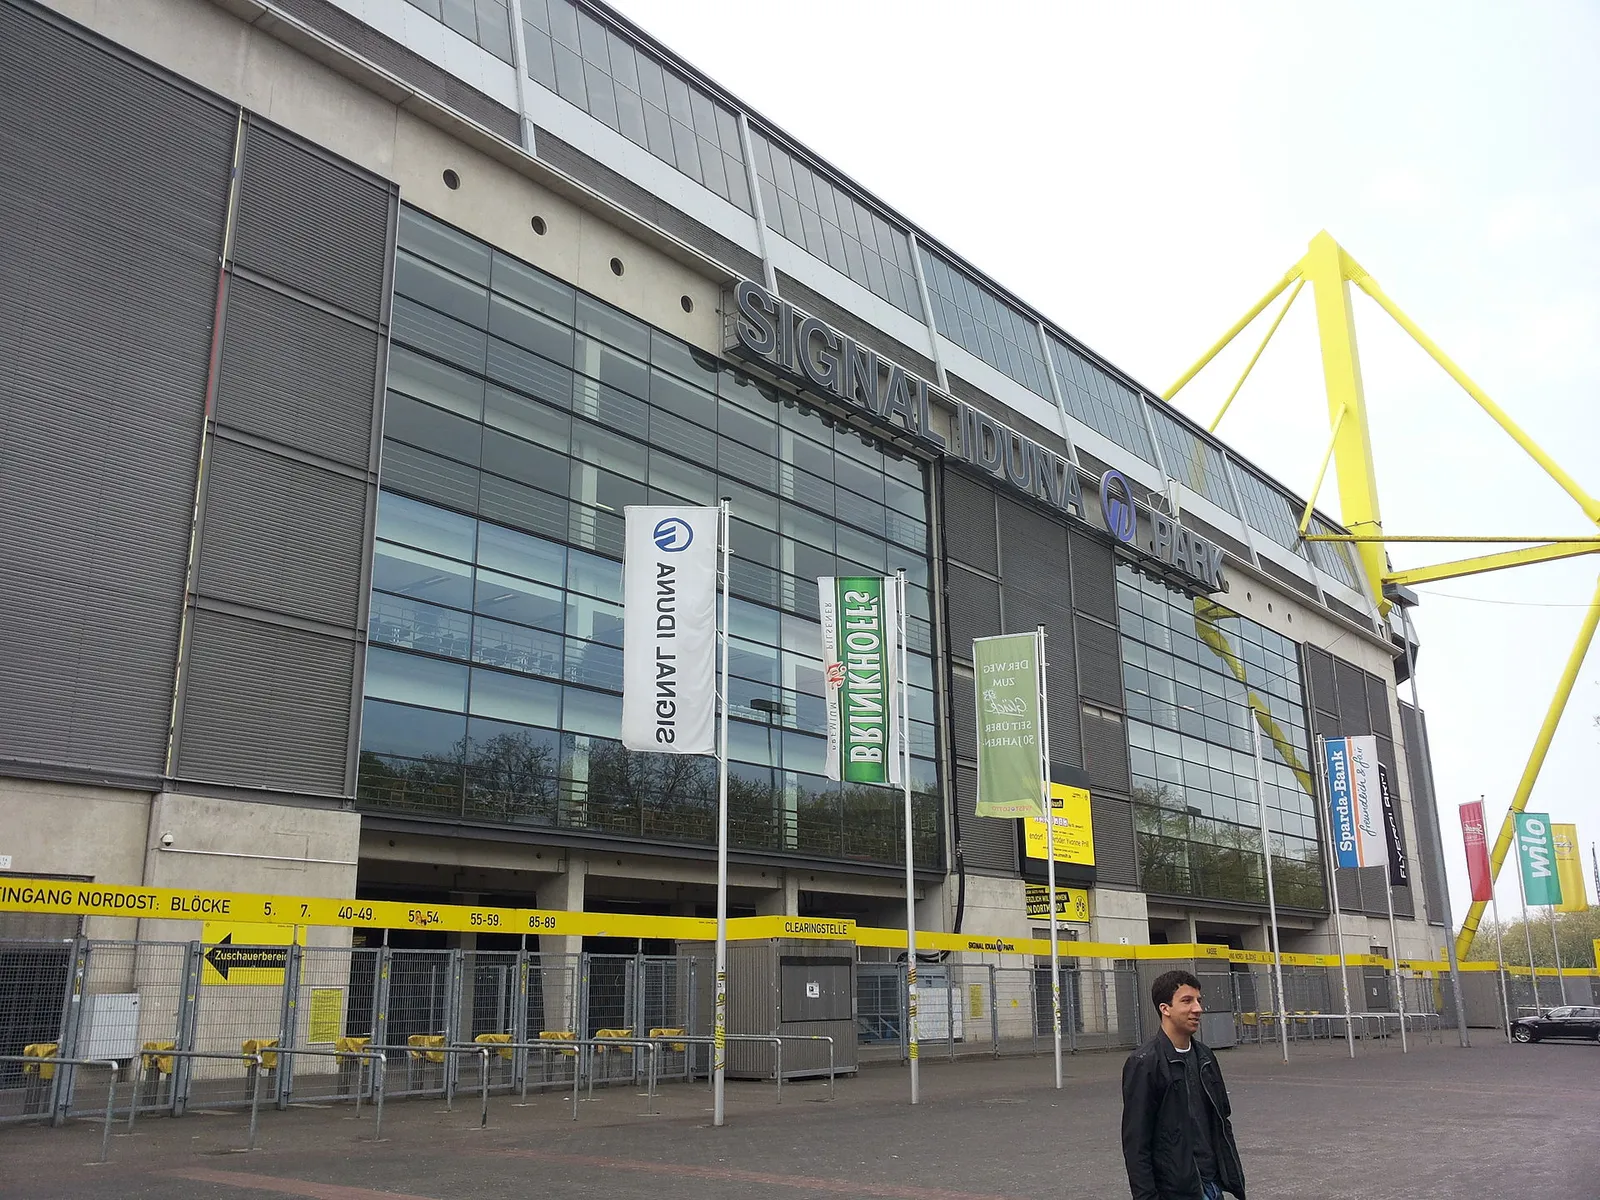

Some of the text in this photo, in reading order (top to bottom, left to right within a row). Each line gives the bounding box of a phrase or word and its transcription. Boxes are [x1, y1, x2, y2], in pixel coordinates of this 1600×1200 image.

[734, 280, 1229, 593] SIGNAL IDUNA PARK
[1352, 747, 1371, 769] fair
[1331, 750, 1355, 851] Sparda-Bank
[1358, 778, 1377, 837] freundlich
[1521, 818, 1551, 878] wilo
[170, 895, 231, 914] BLÖCKE
[263, 902, 277, 916] 5.
[300, 904, 311, 918] 7.
[338, 906, 377, 921] 40-49.
[470, 913, 502, 926] 55-59.
[528, 916, 556, 929] 85-89
[785, 921, 847, 935] CLEARINGSTELLE
[214, 949, 288, 961] Zuschauerbereic
[1003, 943, 1014, 951] PARK
